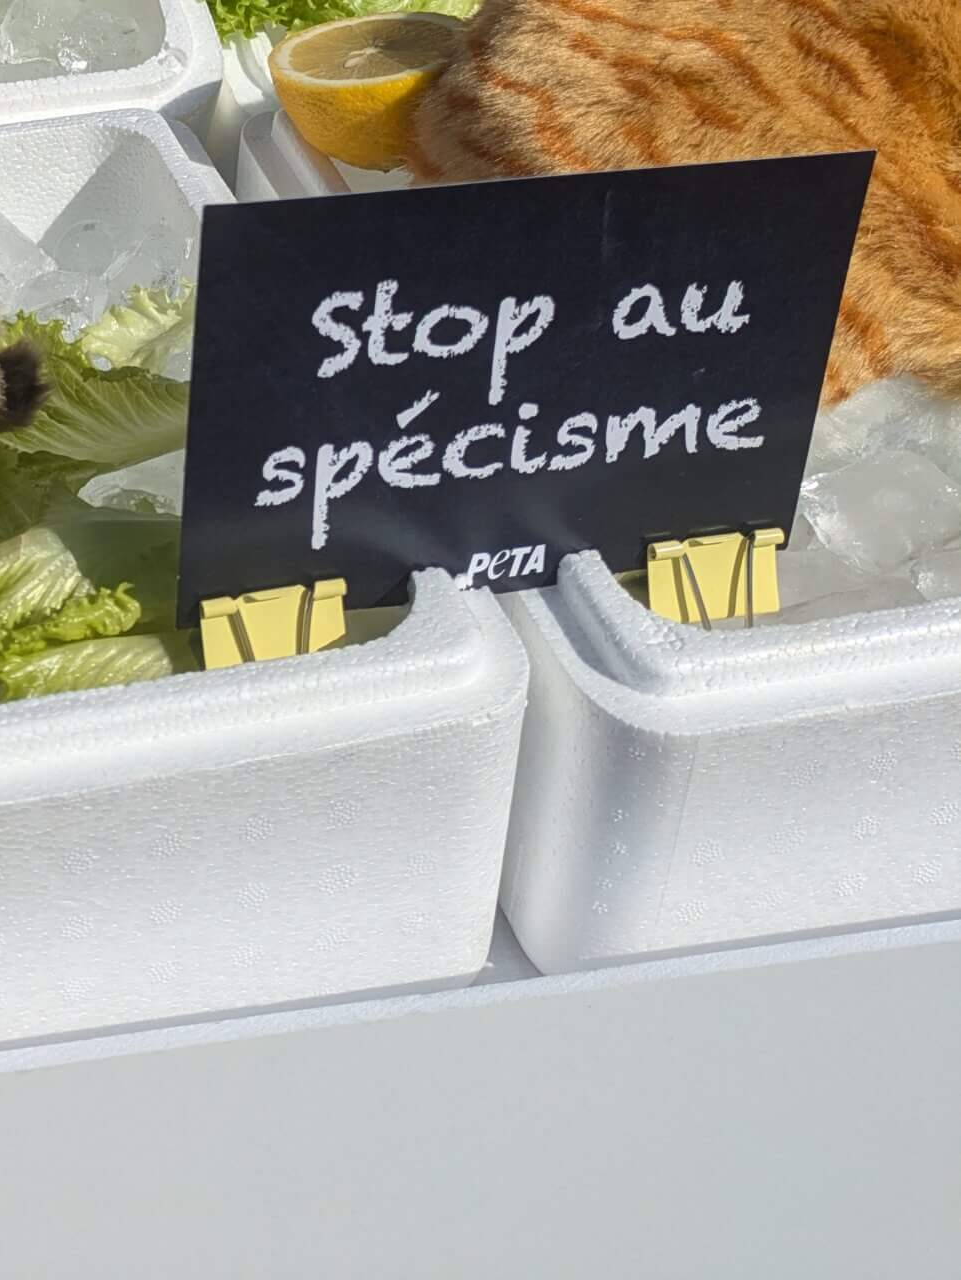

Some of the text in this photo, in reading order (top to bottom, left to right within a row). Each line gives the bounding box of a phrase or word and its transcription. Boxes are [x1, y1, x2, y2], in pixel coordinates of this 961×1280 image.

[311, 279, 751, 406] Stop au
[253, 391, 765, 550] spécisme
